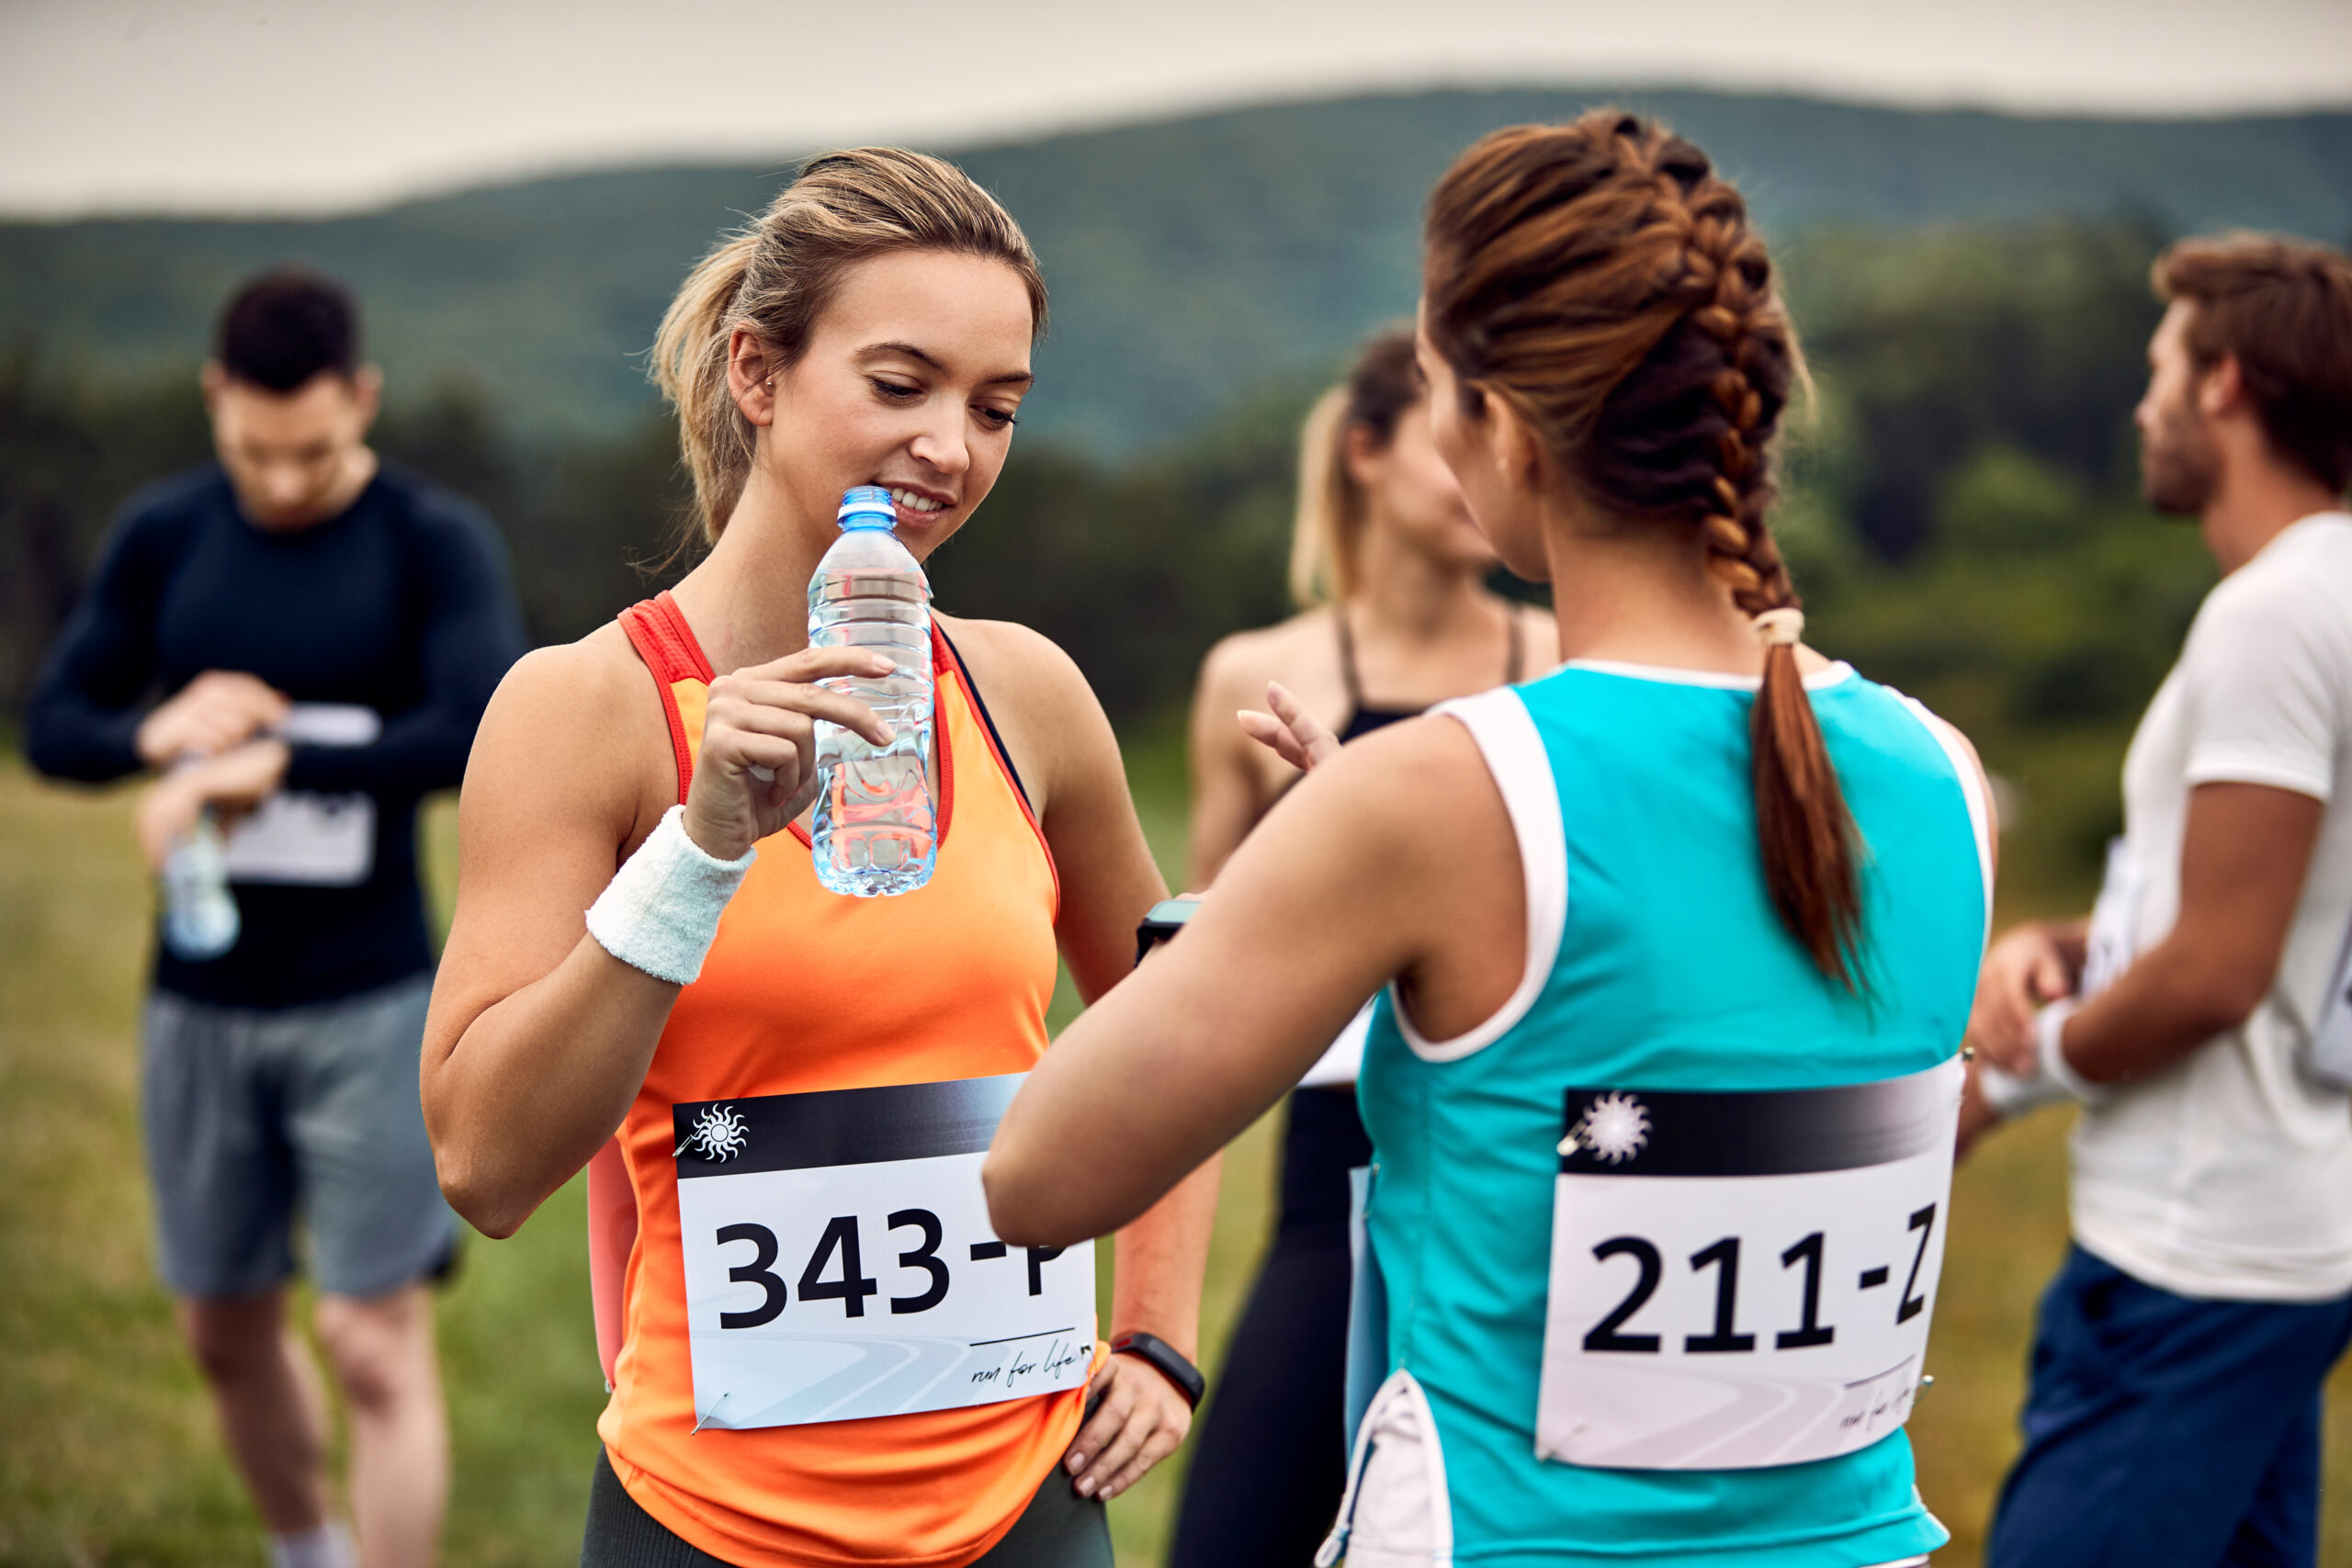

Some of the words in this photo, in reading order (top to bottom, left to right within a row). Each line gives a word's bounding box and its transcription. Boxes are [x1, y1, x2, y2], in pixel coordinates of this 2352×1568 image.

[1581, 1201, 1937, 1354] 211-Z
[971, 1367, 1001, 1382] run
[1006, 1350, 1036, 1388] for
[1044, 1338, 1077, 1380] life
